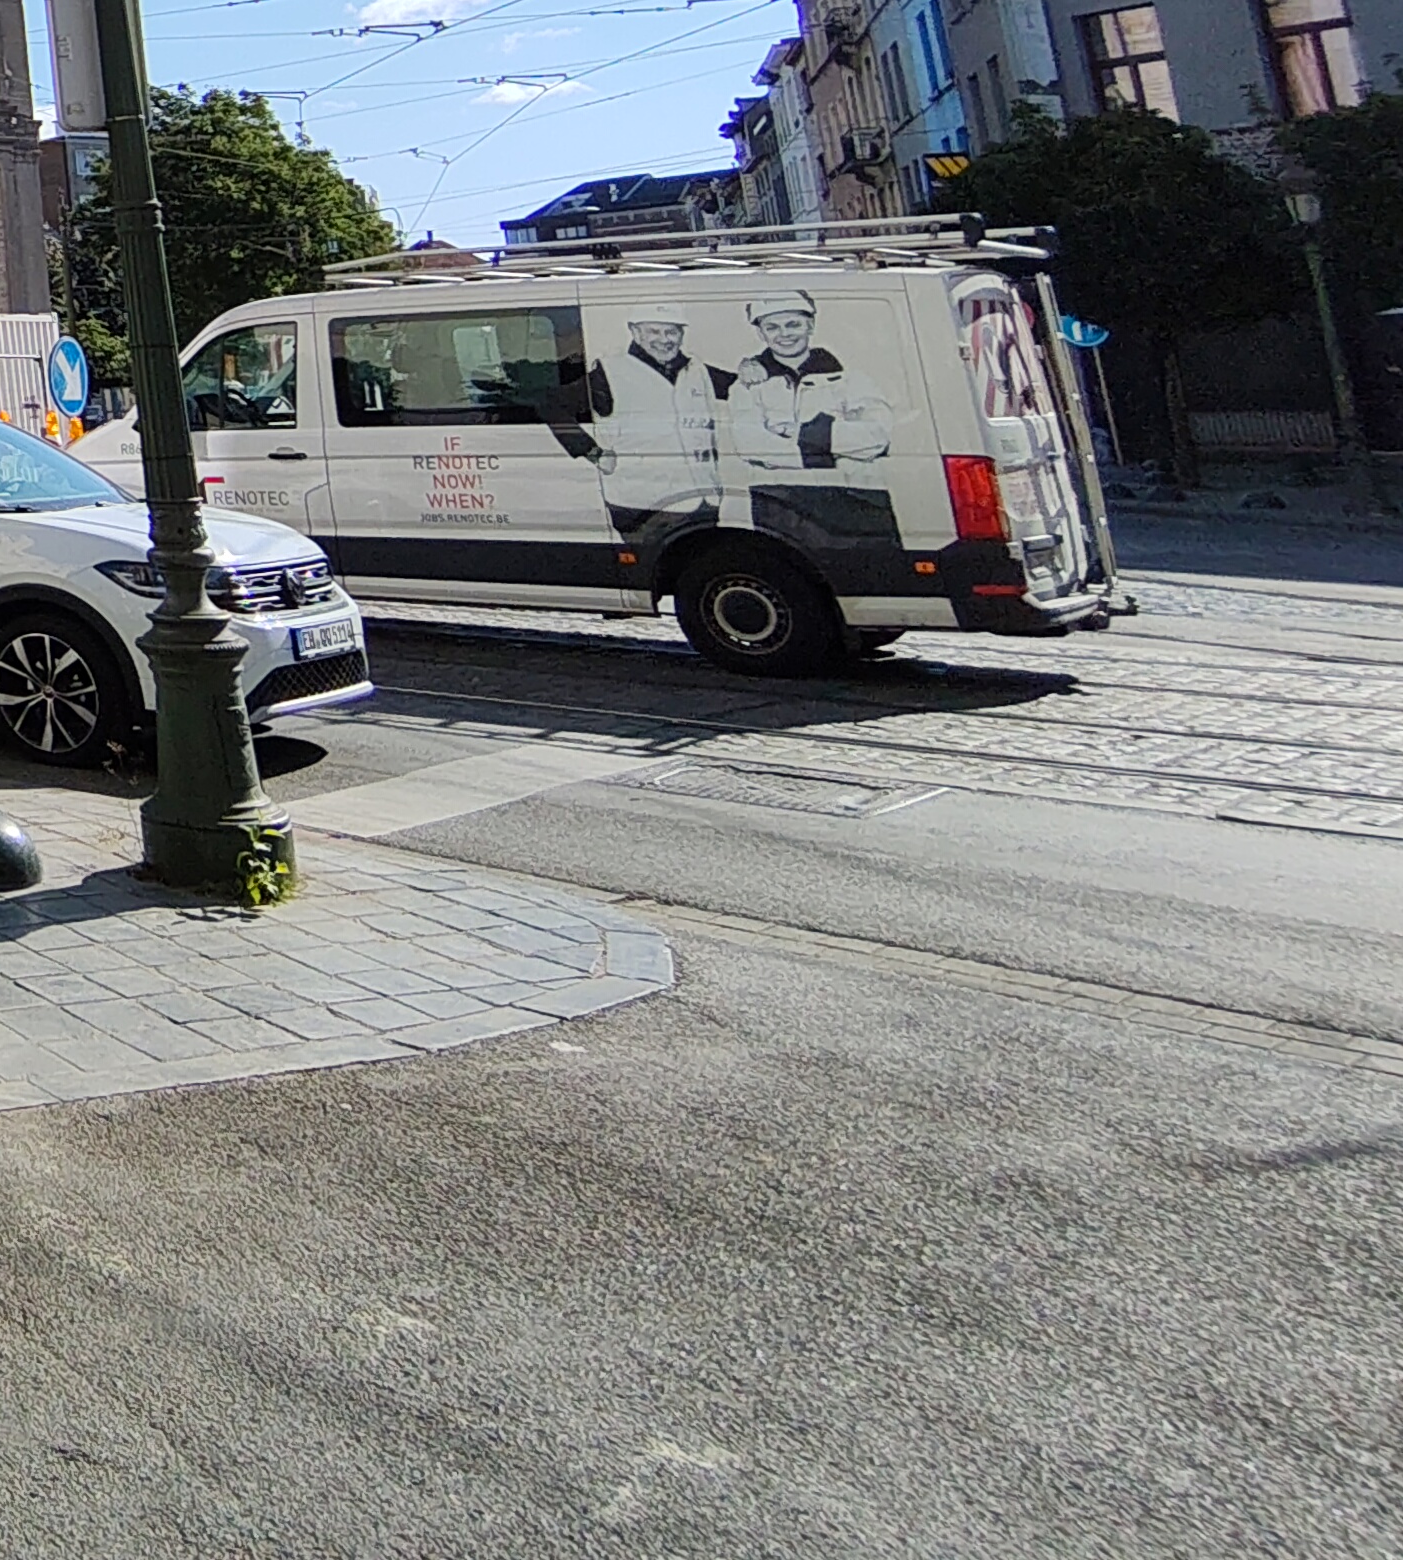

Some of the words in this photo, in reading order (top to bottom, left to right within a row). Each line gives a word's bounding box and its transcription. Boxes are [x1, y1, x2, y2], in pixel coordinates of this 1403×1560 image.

[443, 436, 462, 452] IF
[411, 454, 500, 471] RENOTEC
[432, 473, 484, 490] NOW!
[213, 490, 290, 507] RENOTEC
[425, 492, 495, 510] WHEN?
